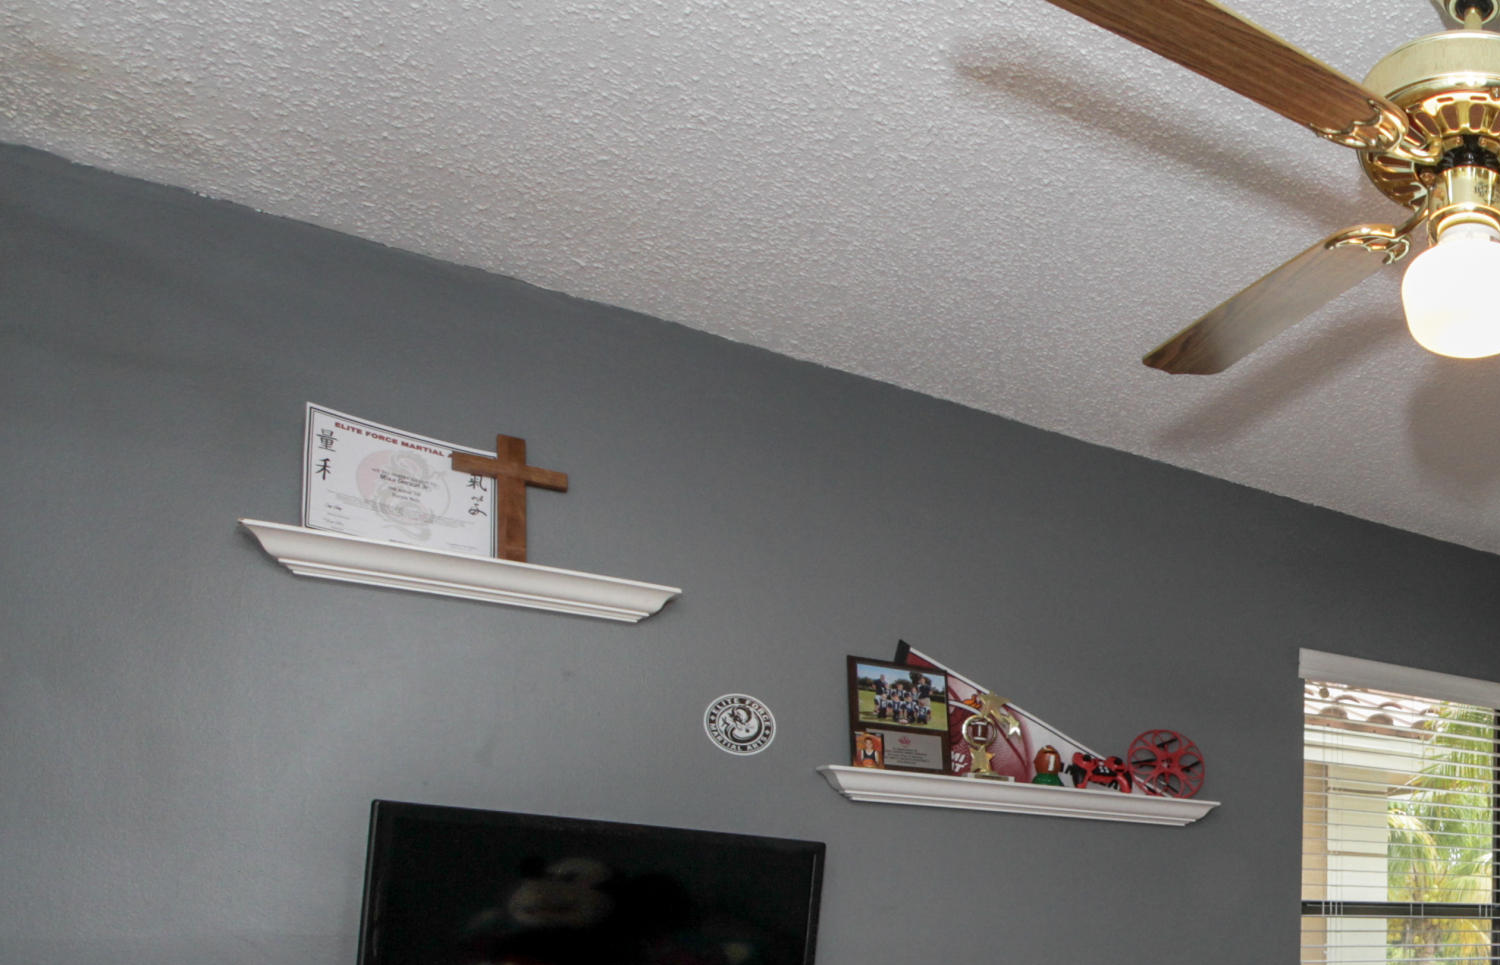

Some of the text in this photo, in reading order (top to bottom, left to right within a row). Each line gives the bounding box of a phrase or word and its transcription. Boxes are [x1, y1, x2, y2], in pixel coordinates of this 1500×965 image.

[334, 421, 363, 435] ELITE
[365, 431, 398, 445] FORCE
[401, 440, 445, 457] MARTIAL
